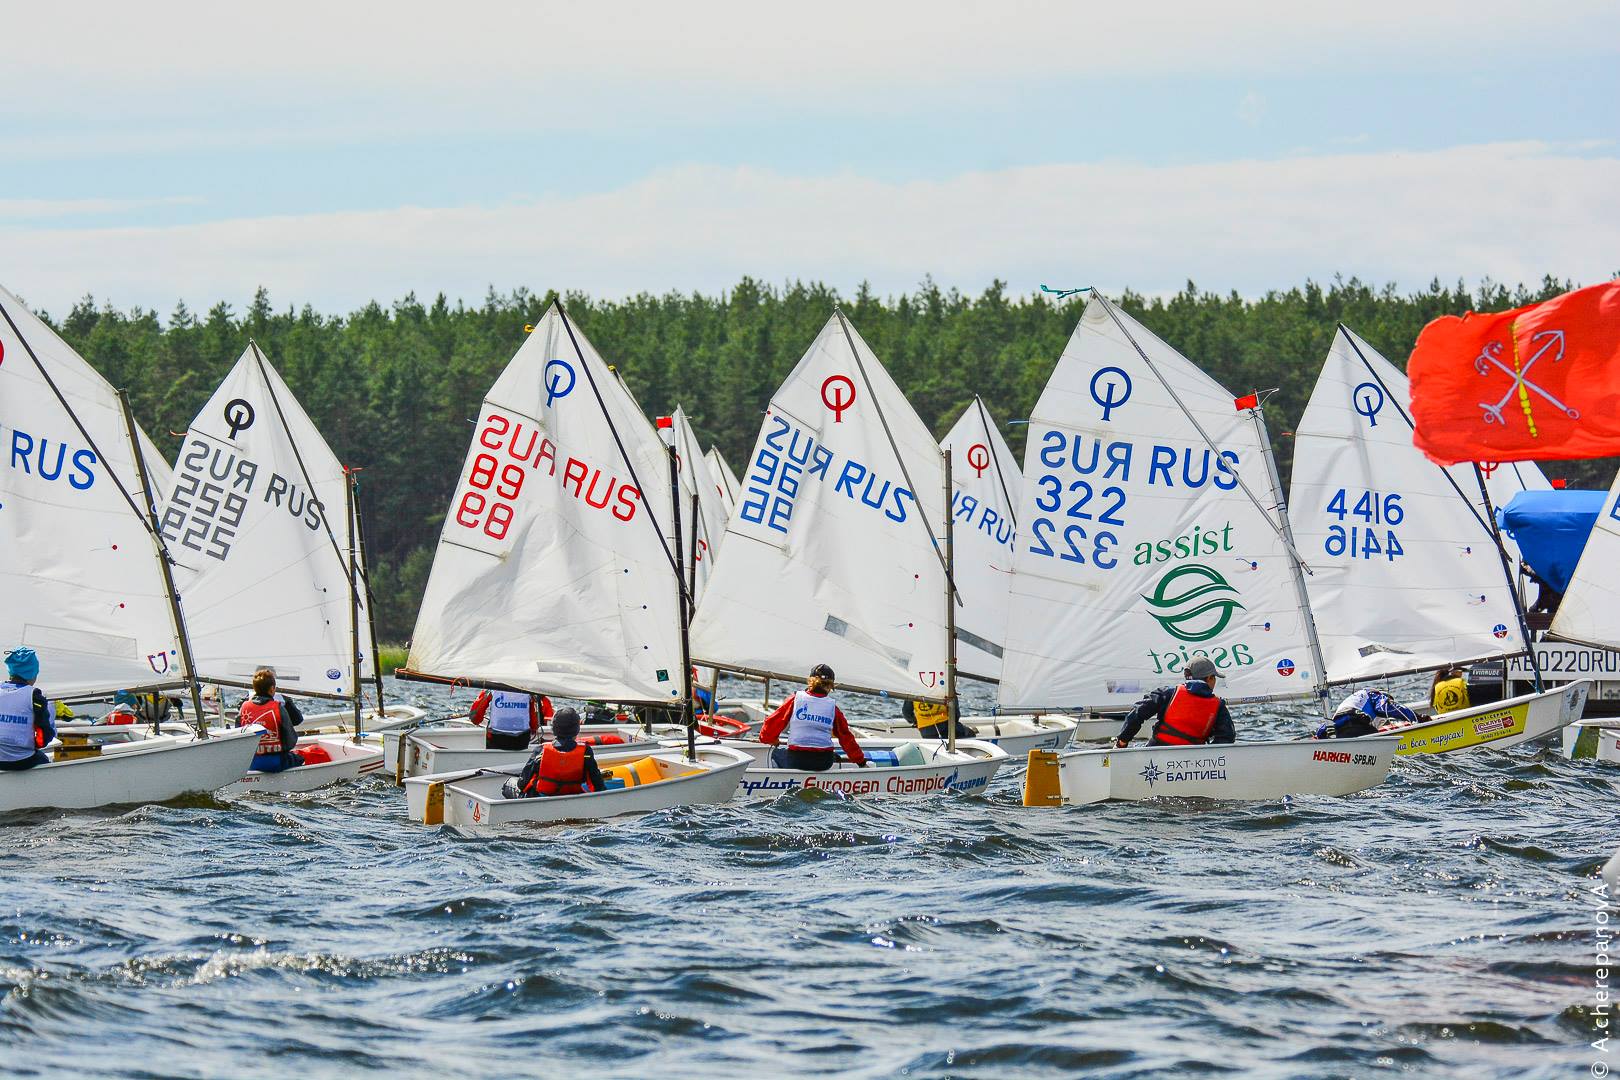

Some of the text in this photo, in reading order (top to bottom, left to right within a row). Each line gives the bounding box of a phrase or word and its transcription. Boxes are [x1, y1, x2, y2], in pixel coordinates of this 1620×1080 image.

[11, 429, 97, 491] RUS
[468, 453, 525, 501] 89
[750, 448, 803, 499] 96
[1148, 445, 1240, 491] RUS
[171, 472, 248, 528] 259
[263, 472, 326, 532] RUS
[562, 456, 642, 523] RUS
[834, 459, 915, 523] RUS
[1035, 474, 1126, 527] 322
[1326, 488, 1404, 525] 4416
[978, 507, 1016, 553] RU
[1133, 521, 1235, 567] assist
[0, 714, 28, 724] AZPROM
[1410, 739, 1427, 748] всех
[1430, 727, 1465, 746] парусах!
[804, 776, 880, 794] European
[1166, 770, 1227, 782] БАЛТИЕЦ
